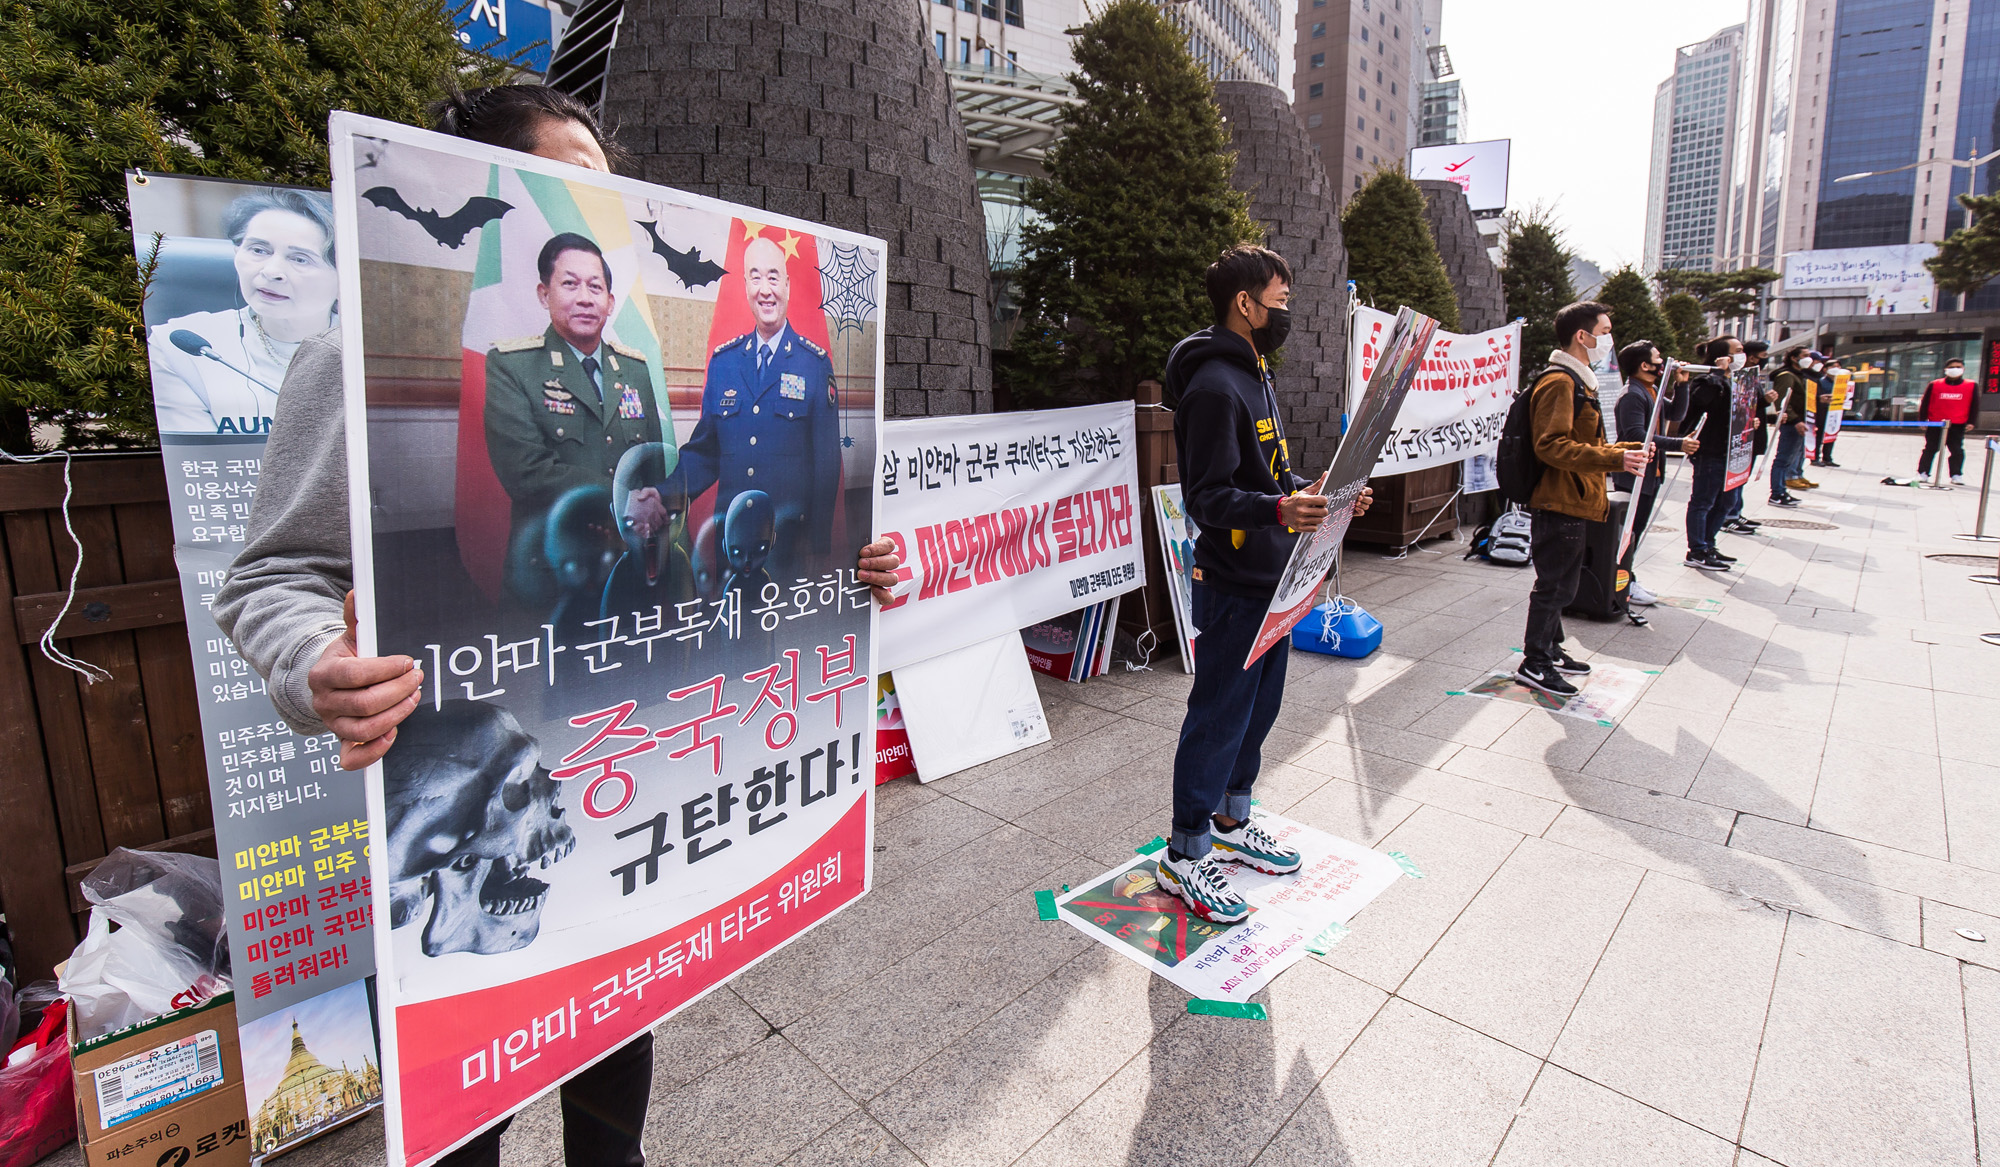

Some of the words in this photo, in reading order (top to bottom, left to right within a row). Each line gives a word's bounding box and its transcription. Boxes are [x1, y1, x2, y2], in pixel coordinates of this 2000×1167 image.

[181, 461, 219, 478] 한국
[226, 458, 261, 476] 국민
[907, 443, 960, 491] 미얀마
[966, 442, 999, 483] 군부
[1004, 434, 1069, 476] 쿠데타군
[1067, 427, 1121, 464] 지원하는
[184, 481, 257, 500] 아웅산수
[192, 525, 246, 543] 요구합
[914, 502, 1051, 601] 미얀마에서
[1051, 484, 1133, 563] 물러가라
[1069, 577, 1089, 598] 미얀마
[1089, 570, 1112, 592] 군부독재
[1111, 566, 1123, 586] 타도
[575, 588, 741, 673] 군부독재
[752, 568, 872, 632] 옹호하는
[212, 678, 266, 703] 있습니
[219, 720, 293, 749] 민주주의
[548, 634, 868, 820] 중국정부
[222, 741, 296, 773] 민주화를
[303, 733, 338, 754] 요구
[876, 742, 908, 764] 미얀마
[225, 767, 286, 797] 것이며
[228, 782, 328, 819] 지지합니다.
[609, 733, 861, 897] 규탄한다!
[234, 835, 302, 871] 미얀마
[309, 819, 370, 852] 군부는
[238, 865, 306, 902] 미얀마
[313, 850, 357, 881] 민주
[243, 894, 311, 931] 미얀마
[317, 876, 372, 911] 군부는
[247, 924, 314, 963] 미얀마
[1194, 944, 1231, 970] 미얀마
[250, 944, 349, 999] 돌려줘라!
[461, 996, 582, 1090] 미얀마
[589, 921, 714, 1025] 군부독재
[720, 894, 771, 944] 타도
[777, 851, 842, 914] 위원회
[1220, 975, 1243, 994] MIN
[1240, 955, 1270, 978] AUNG
[165, 1044, 179, 1055] F3
[106, 1130, 163, 1161] 파손주의
